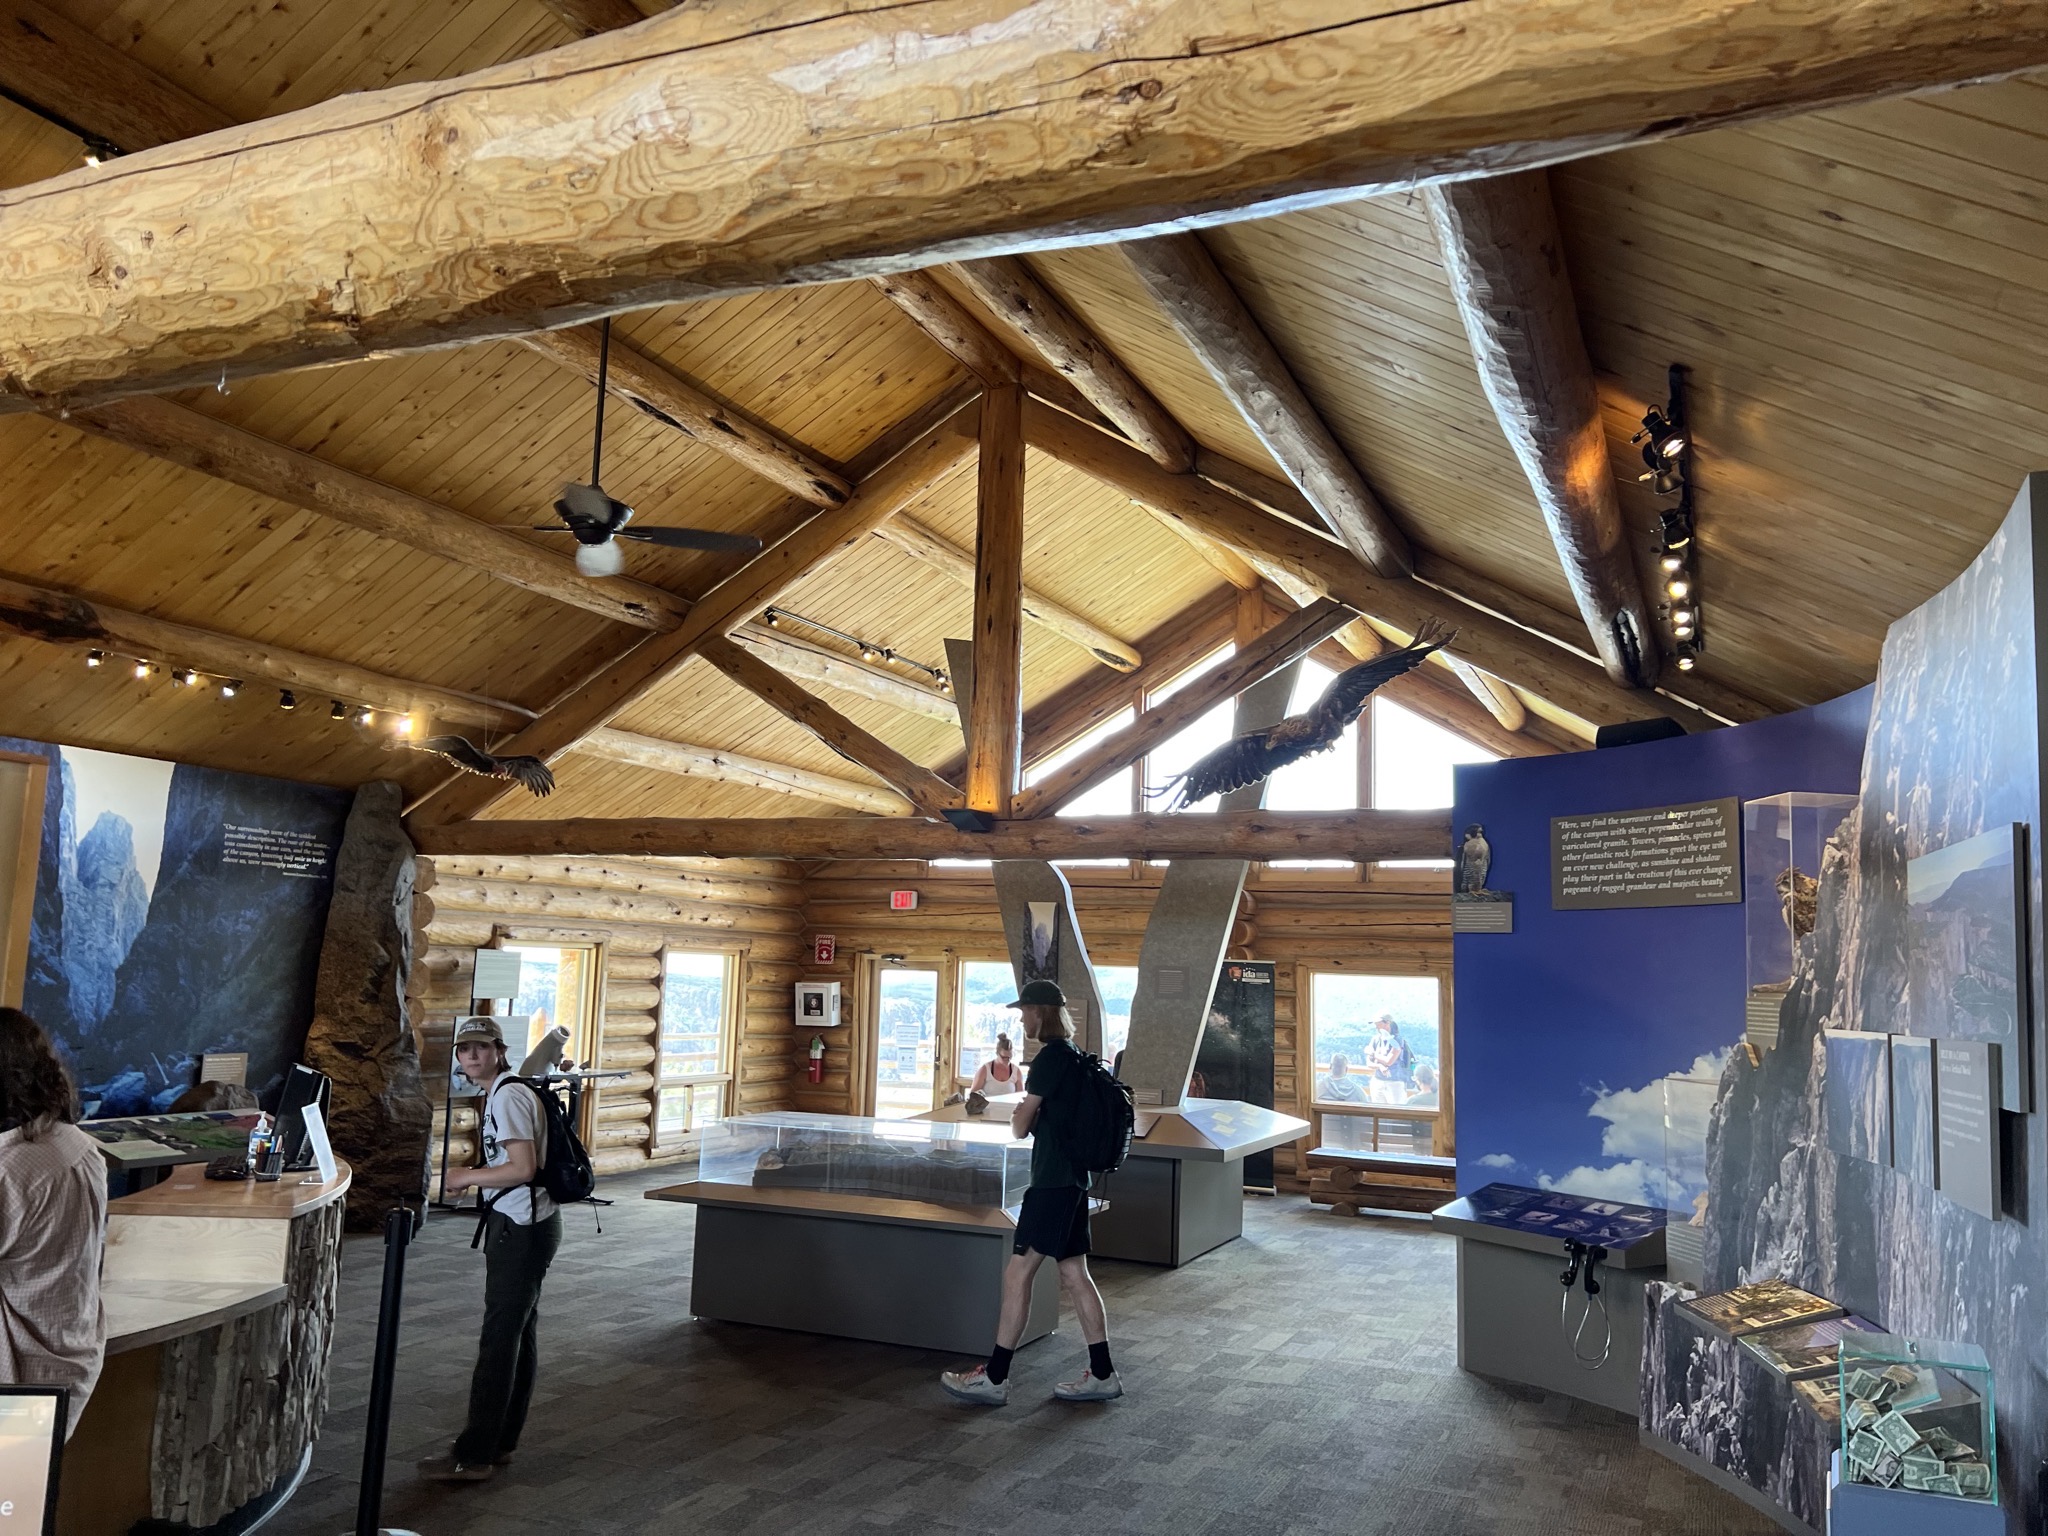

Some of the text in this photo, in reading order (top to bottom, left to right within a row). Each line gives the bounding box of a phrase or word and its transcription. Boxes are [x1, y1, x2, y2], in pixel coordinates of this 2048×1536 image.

[1592, 818, 1606, 828] find
[1653, 812, 1666, 820] and
[1668, 811, 1689, 820] deeper
[1690, 807, 1718, 819] portions
[238, 827, 269, 835] surroundings
[1562, 832, 1570, 841] of
[1583, 831, 1608, 839] canyon
[1648, 821, 1694, 834] perpendicular
[1696, 818, 1713, 827] walls
[1715, 816, 1723, 827] of
[1562, 840, 1601, 850] varicolored
[1603, 839, 1630, 850] granite.
[1658, 833, 1691, 845] pinnacles,
[1693, 831, 1711, 841] spires
[1713, 828, 1726, 837] and
[1563, 853, 1581, 861] other
[1582, 851, 1613, 862] fantastic
[1631, 847, 1668, 859] formations
[1670, 845, 1686, 855] greet
[1688, 843, 1698, 851] the
[1700, 844, 1710, 852] eye
[1712, 841, 1727, 849] with
[1606, 861, 1639, 870] challenge,
[1651, 857, 1679, 866] sunshine
[1682, 855, 1694, 863] and
[1696, 854, 1721, 863] shadow
[1563, 875, 1579, 884] play
[1599, 874, 1614, 883] part
[1637, 870, 1664, 878] creation
[1666, 868, 1674, 879] of
[1703, 864, 1732, 875] changing
[1563, 886, 1591, 895] pageant
[1593, 884, 1601, 894] of
[1602, 883, 1625, 893] rugged
[1626, 882, 1657, 892] grandeur
[1672, 879, 1700, 890] majestic
[894, 892, 912, 908] EXIT
